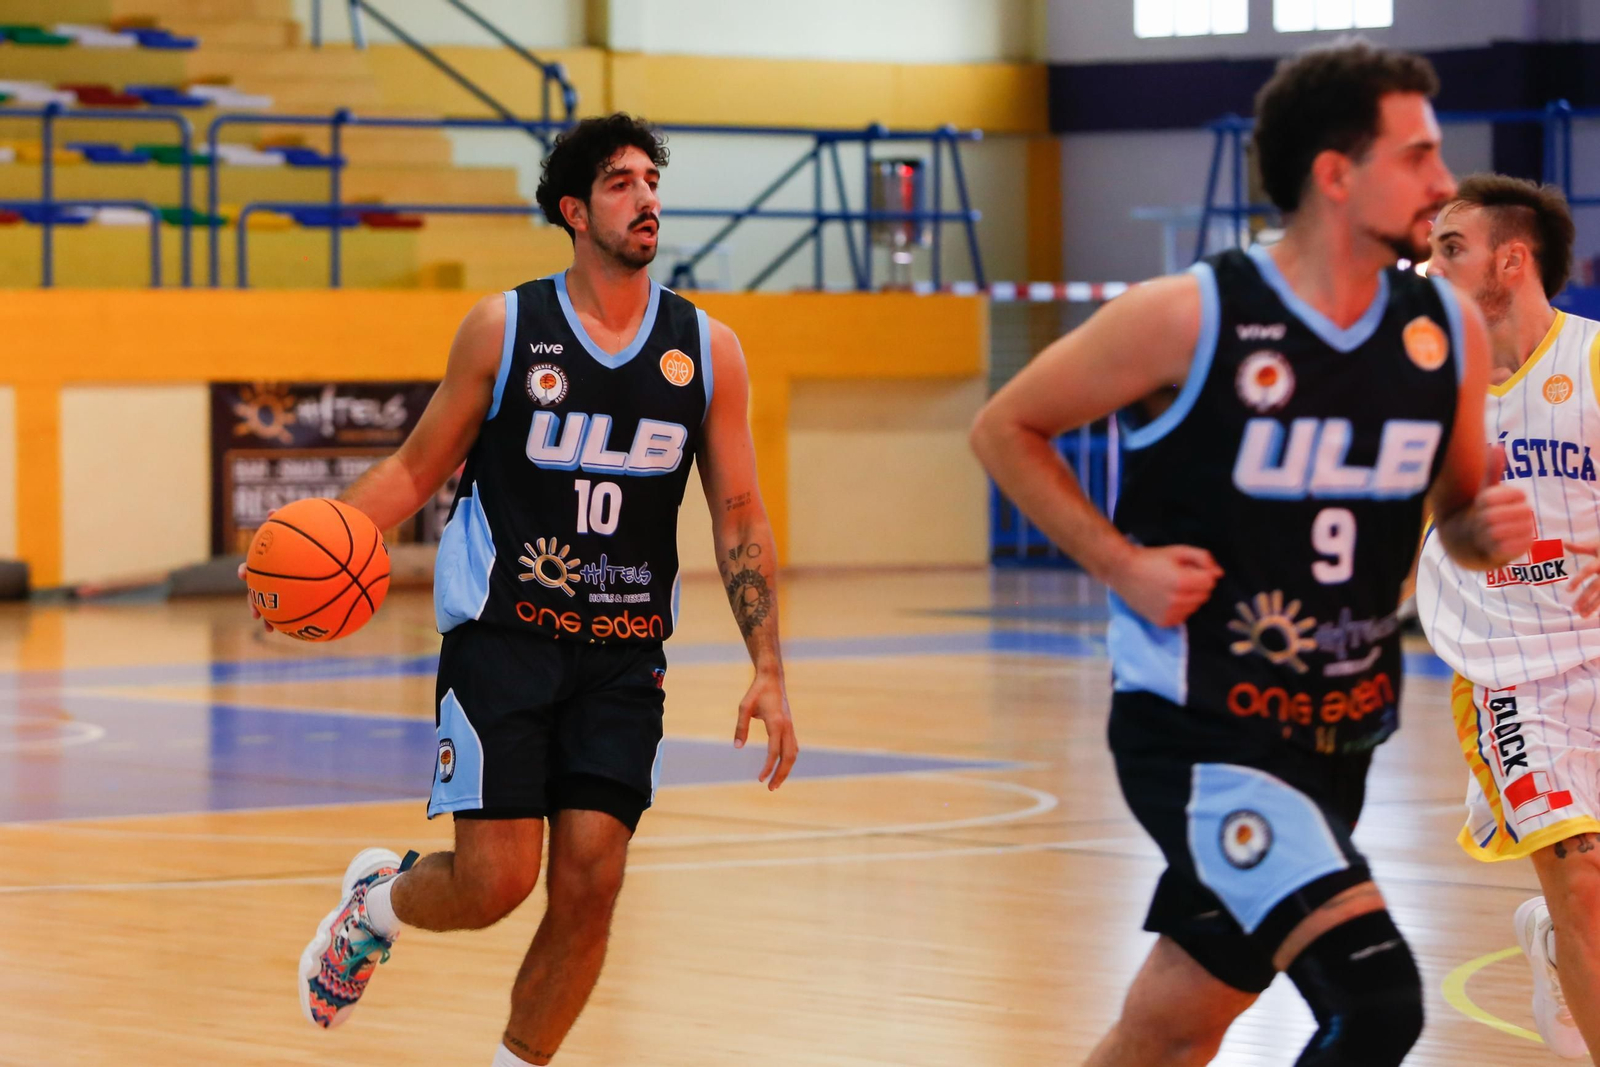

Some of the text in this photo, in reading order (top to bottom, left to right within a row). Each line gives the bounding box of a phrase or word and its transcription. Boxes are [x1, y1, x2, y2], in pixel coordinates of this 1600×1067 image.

[530, 342, 563, 354] vive
[525, 410, 687, 476] ULB
[1231, 416, 1443, 501] ULB
[574, 478, 623, 536] 10
[1311, 506, 1357, 585] 9
[1489, 696, 1528, 777] BLOCK
